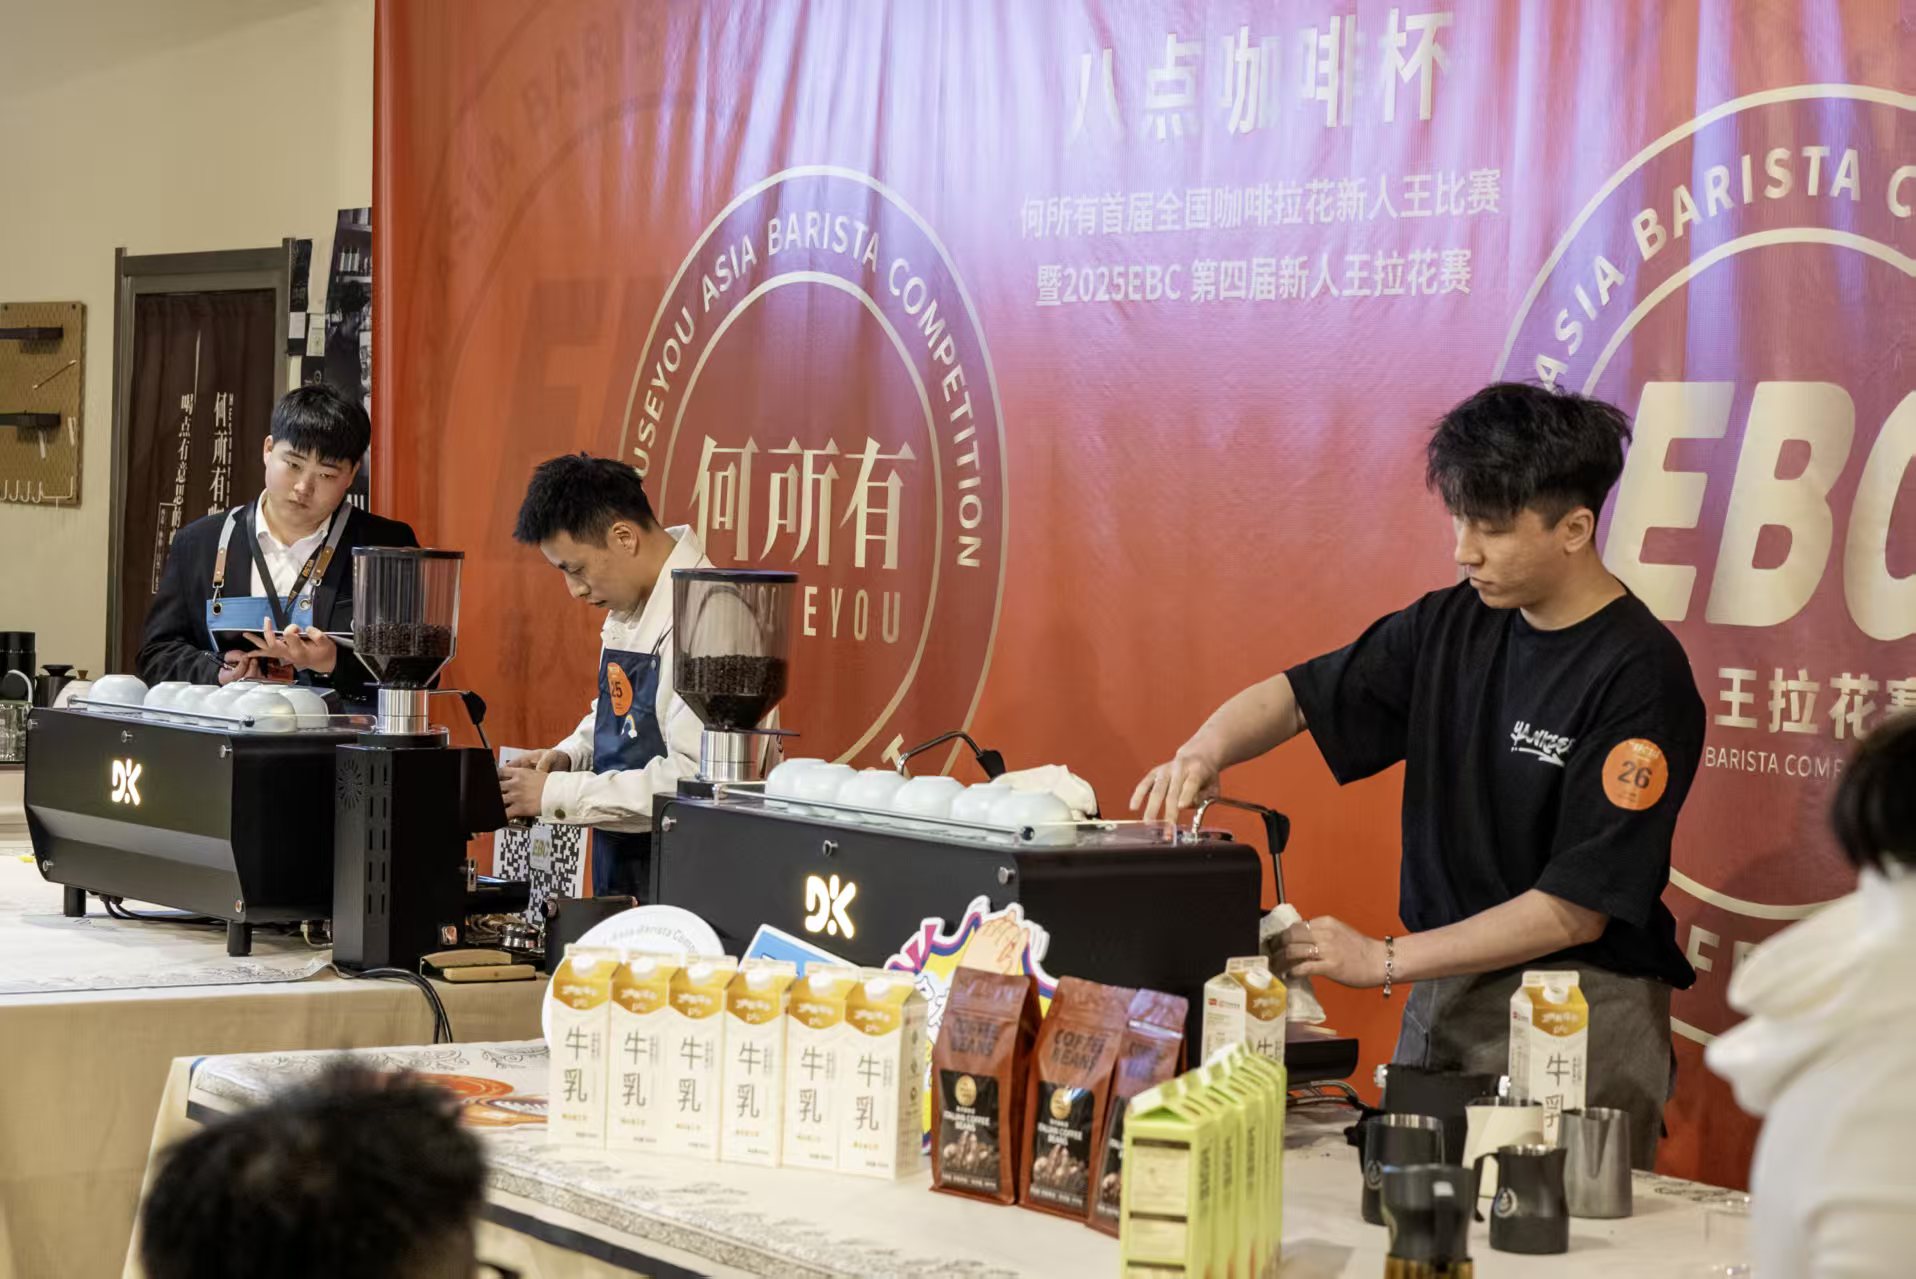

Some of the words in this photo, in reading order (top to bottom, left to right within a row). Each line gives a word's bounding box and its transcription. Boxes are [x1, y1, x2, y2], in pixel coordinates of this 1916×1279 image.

[1068, 8, 1454, 145] 八点咖啡杯
[1020, 168, 1501, 239] 何所有首届全国咖啡拉花新人王比赛
[1036, 264, 1181, 306] 暨2025EBC
[1190, 249, 1472, 303] 第四届新人王拉花赛
[1534, 255, 1625, 396] ASIA
[1631, 146, 1861, 261] BARISTA
[633, 306, 696, 479] USEYOU
[701, 235, 757, 312] ASIA
[767, 211, 880, 273] BARISTA
[888, 258, 984, 568] COMPETITION
[688, 434, 916, 570] 何所有
[803, 586, 900, 644] EYOU
[1617, 760, 1652, 789] 26
[1705, 746, 1779, 775] BARISTA
[1784, 753, 1844, 779] COMP
[563, 1025, 589, 1102] 牛乳
[622, 1029, 648, 1107] 牛乳
[677, 1035, 703, 1112] 牛乳
[736, 1041, 761, 1118] 牛乳
[799, 1045, 824, 1124] 牛乳
[855, 1053, 881, 1131] 牛乳
